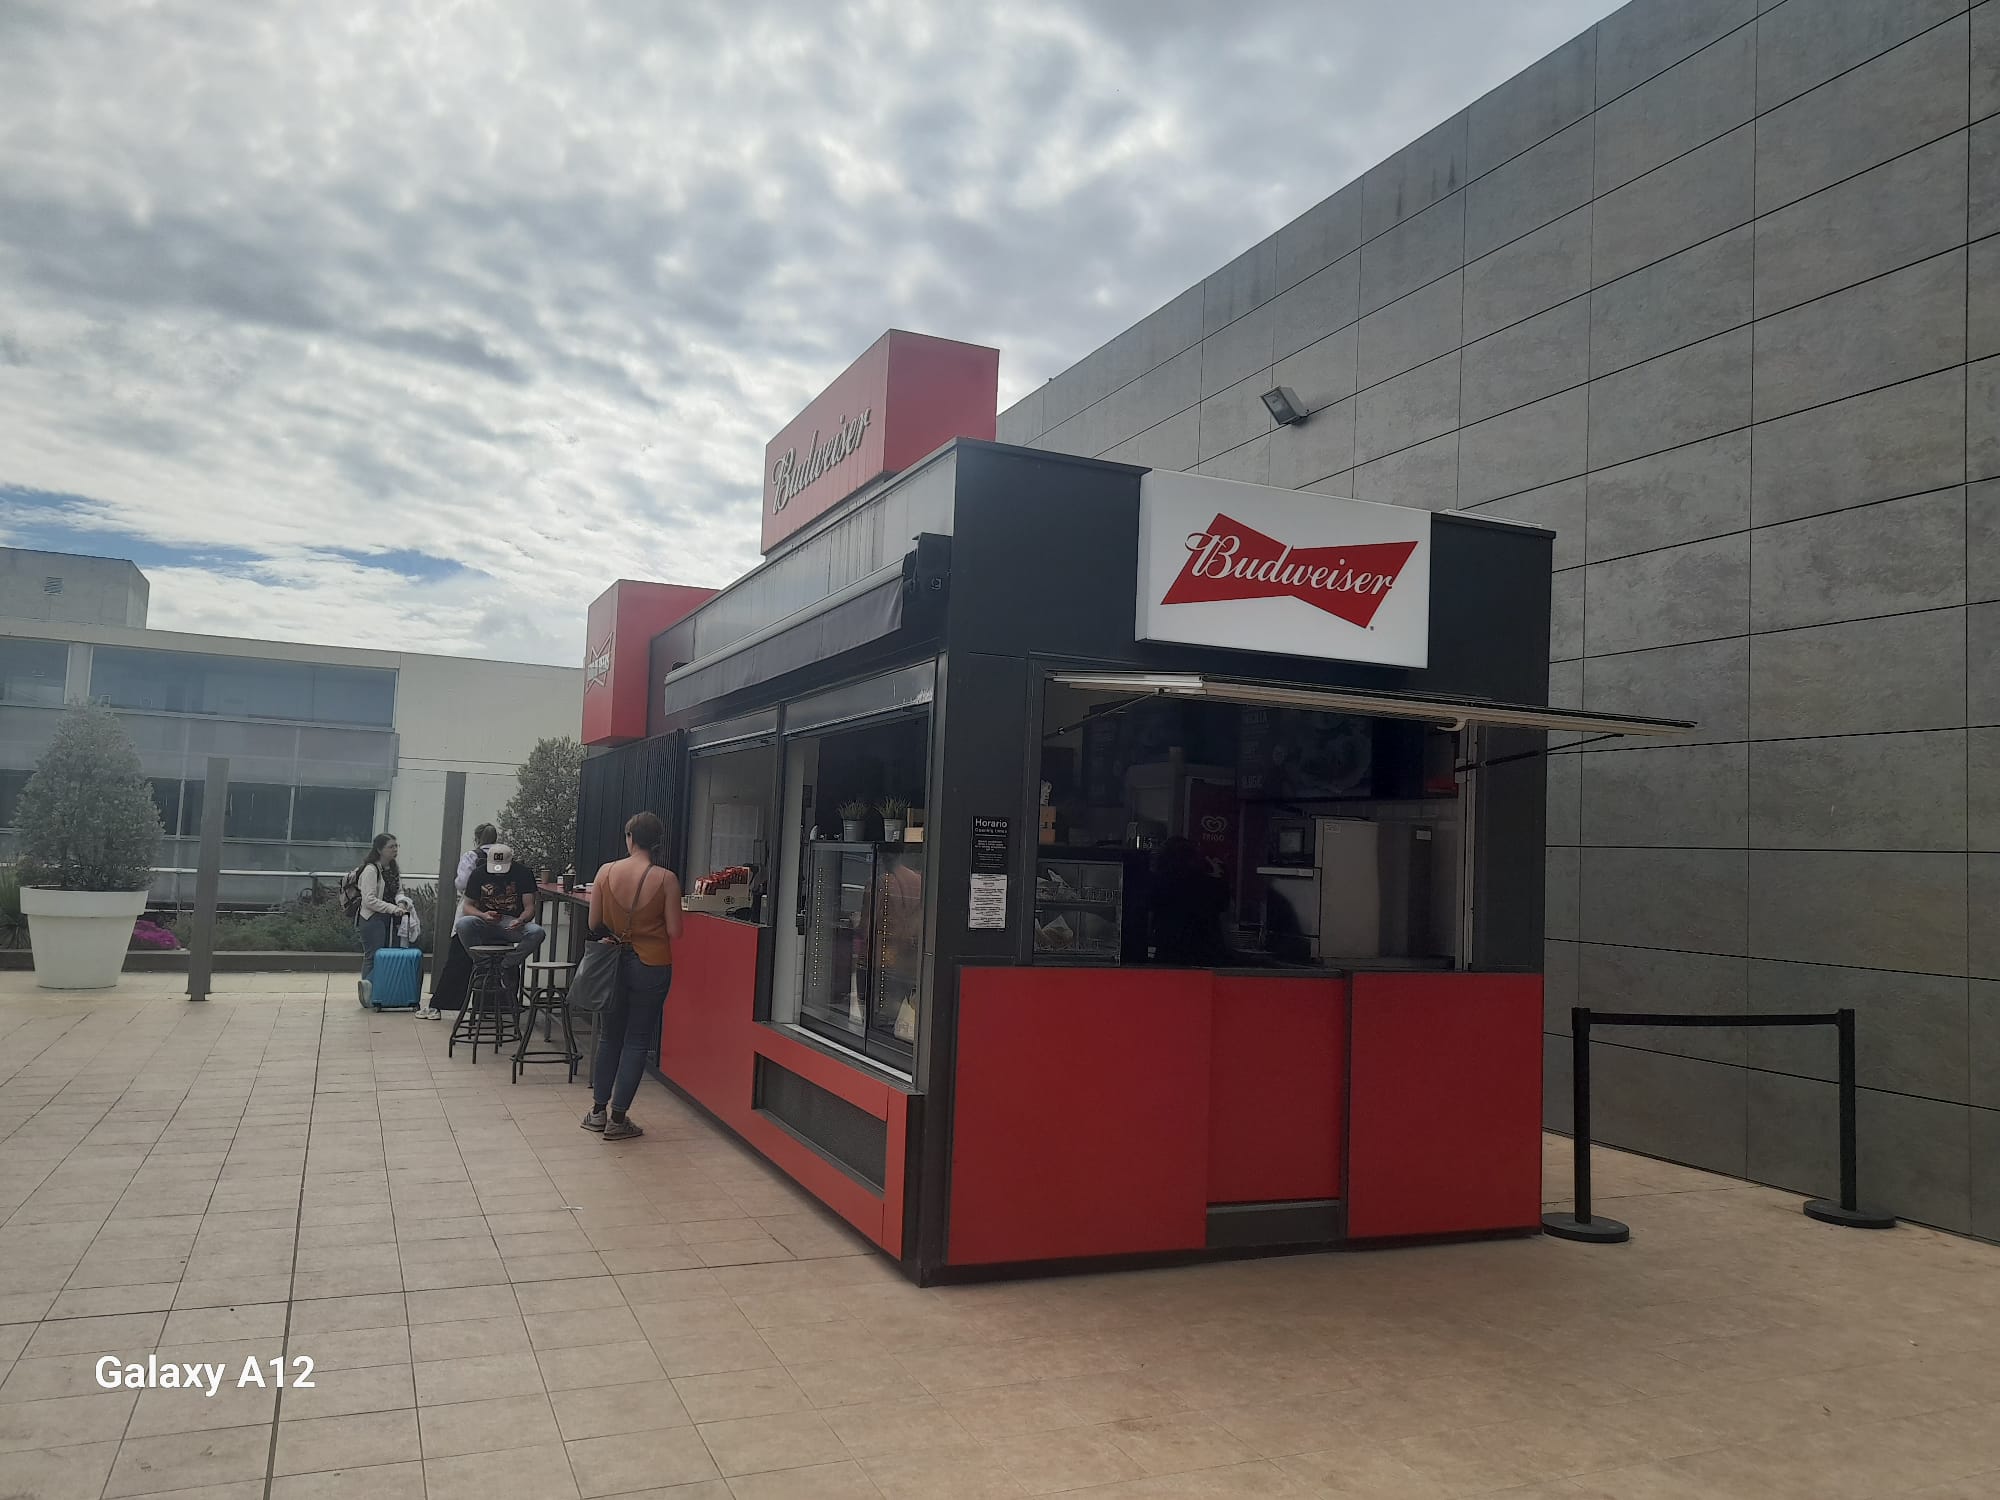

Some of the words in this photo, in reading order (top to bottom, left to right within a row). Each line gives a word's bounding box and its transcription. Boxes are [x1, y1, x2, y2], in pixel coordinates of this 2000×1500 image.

[771, 407, 872, 515] Budweiser
[1184, 531, 1395, 596] Budweiser
[975, 818, 1008, 828] Horario
